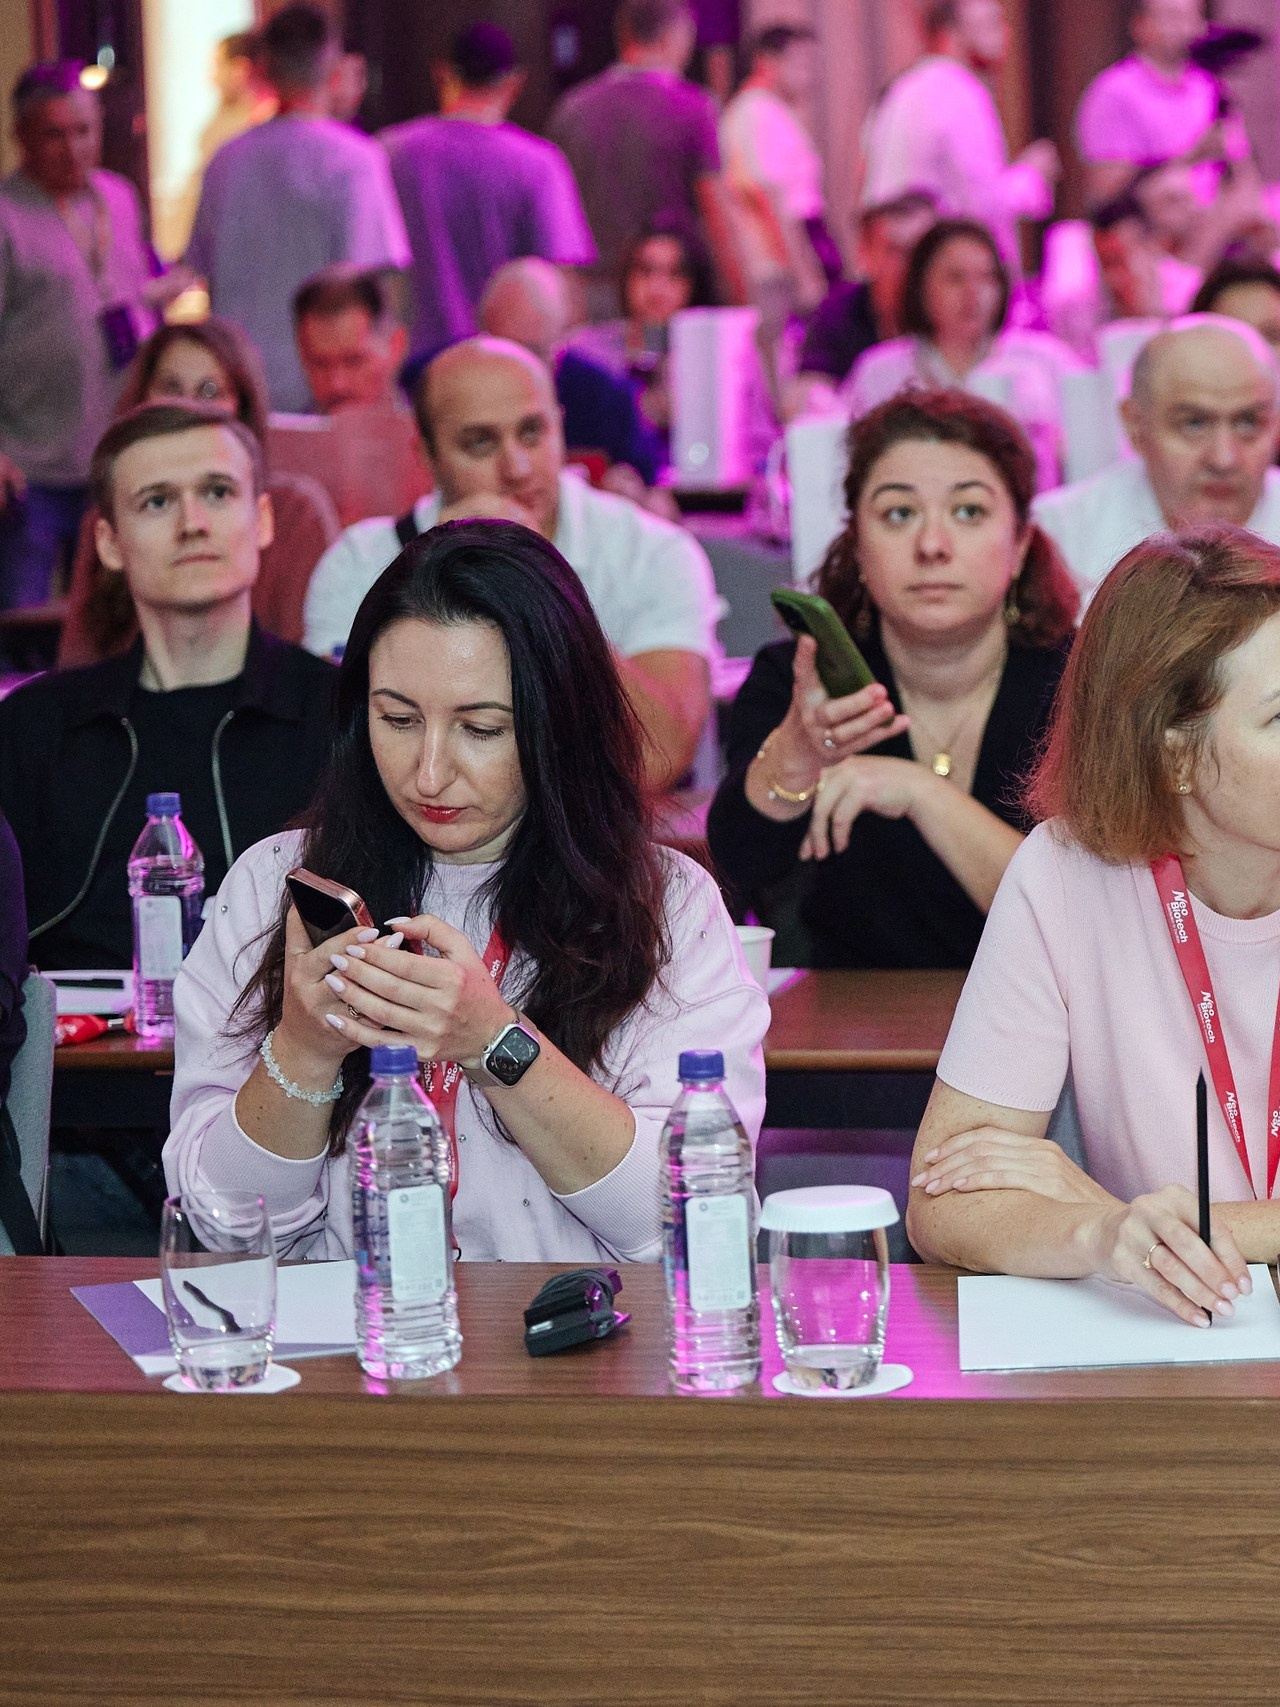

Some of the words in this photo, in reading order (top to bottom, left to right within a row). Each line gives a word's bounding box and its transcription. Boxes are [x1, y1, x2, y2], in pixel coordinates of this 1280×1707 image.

[1172, 890, 1188, 916] Neo
[1171, 902, 1188, 943] Biotech
[1201, 990, 1214, 1016] Neo
[1201, 1002, 1215, 1043] Biotech
[442, 1067, 453, 1093] Neo
[1226, 1090, 1238, 1116] Neo
[1226, 1102, 1240, 1142] Biotech
[1271, 1110, 1279, 1137] Neo
